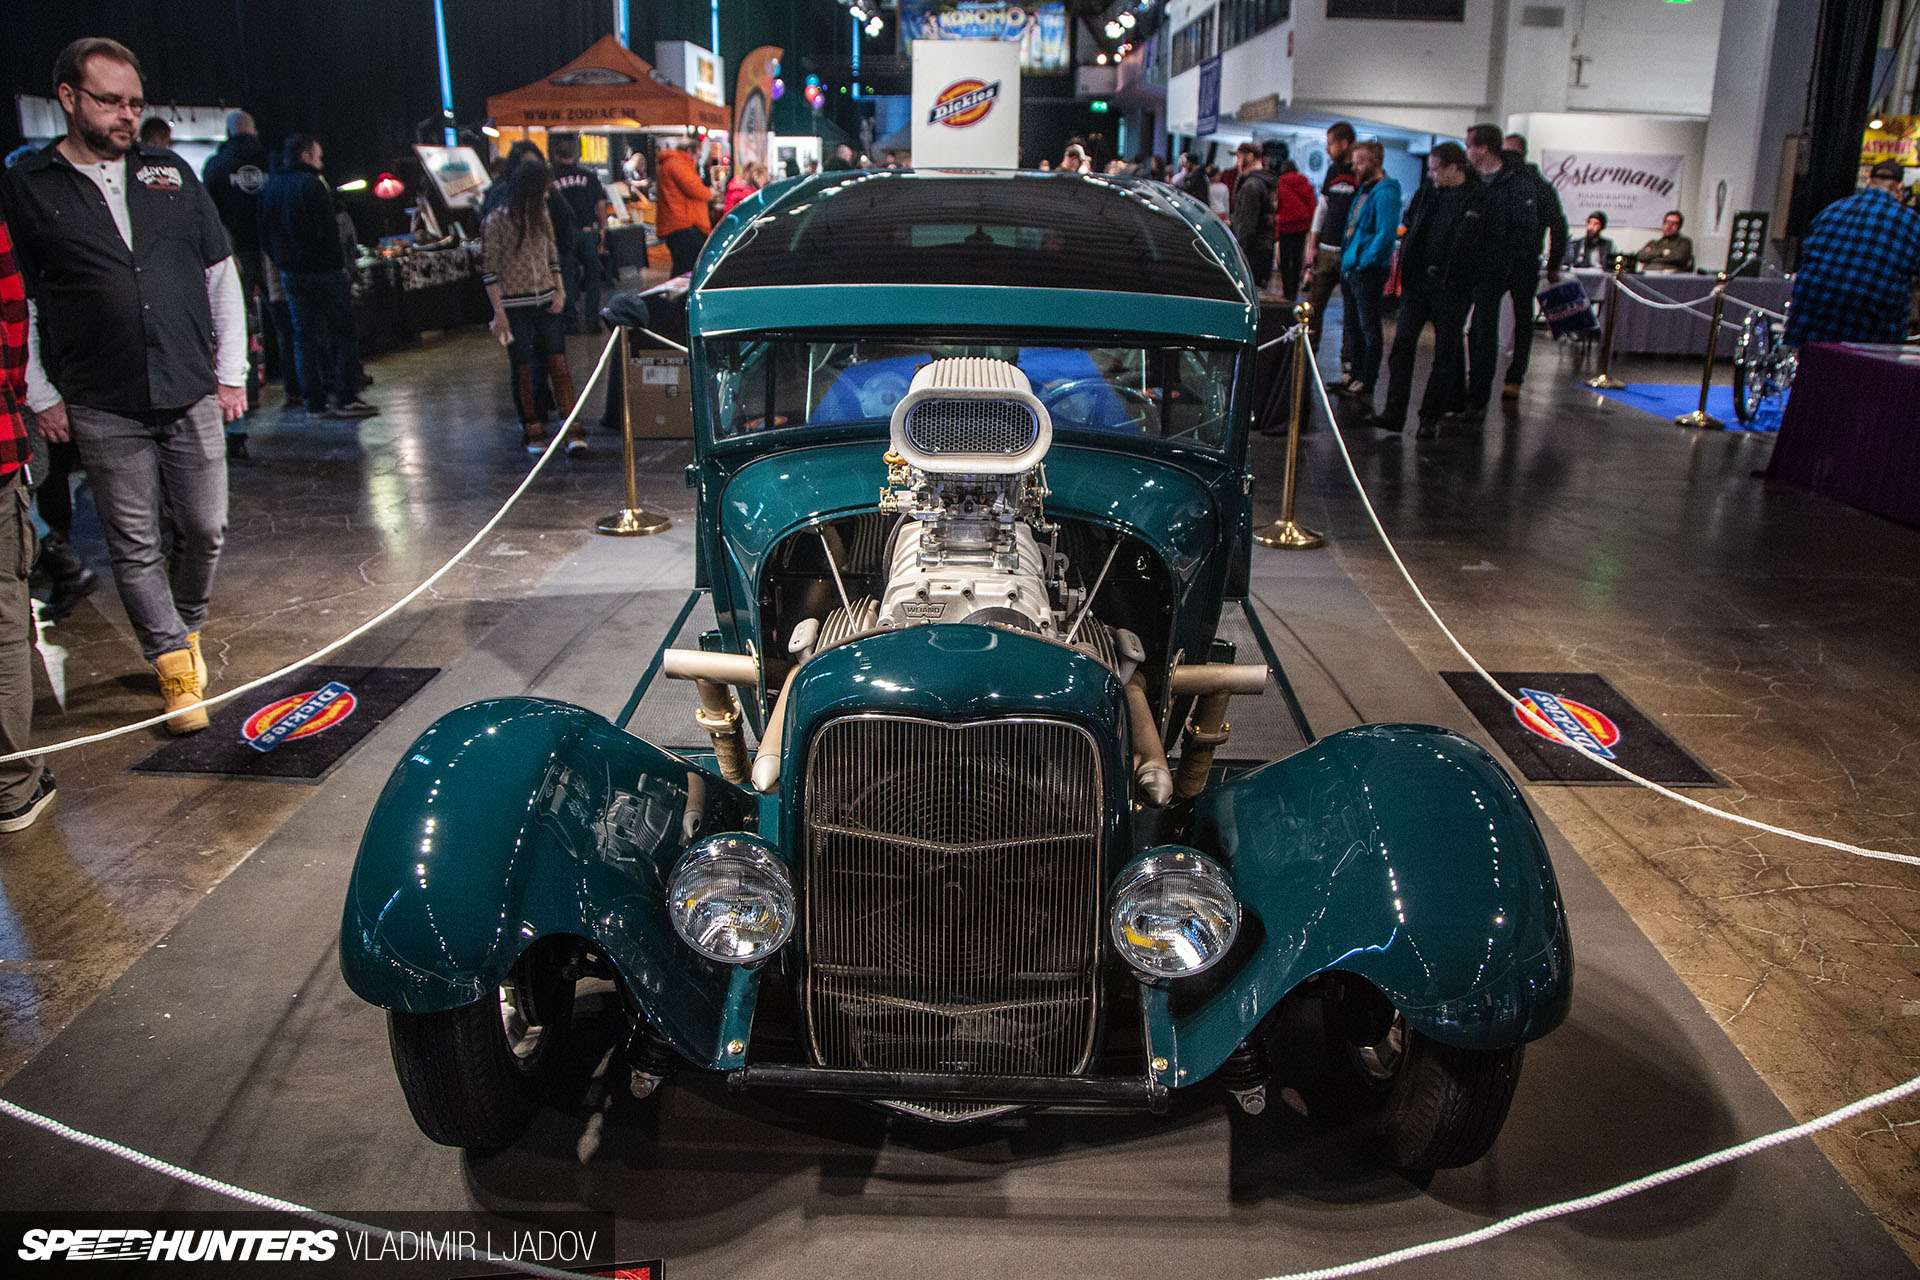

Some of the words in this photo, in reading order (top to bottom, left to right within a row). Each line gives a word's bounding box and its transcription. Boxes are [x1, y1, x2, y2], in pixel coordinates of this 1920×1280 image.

[934, 87, 995, 119] Dickies
[1545, 154, 1675, 197] Estermann
[907, 606, 940, 614] WEIAND
[261, 688, 340, 744] Dickies
[1535, 694, 1602, 752] Dickies
